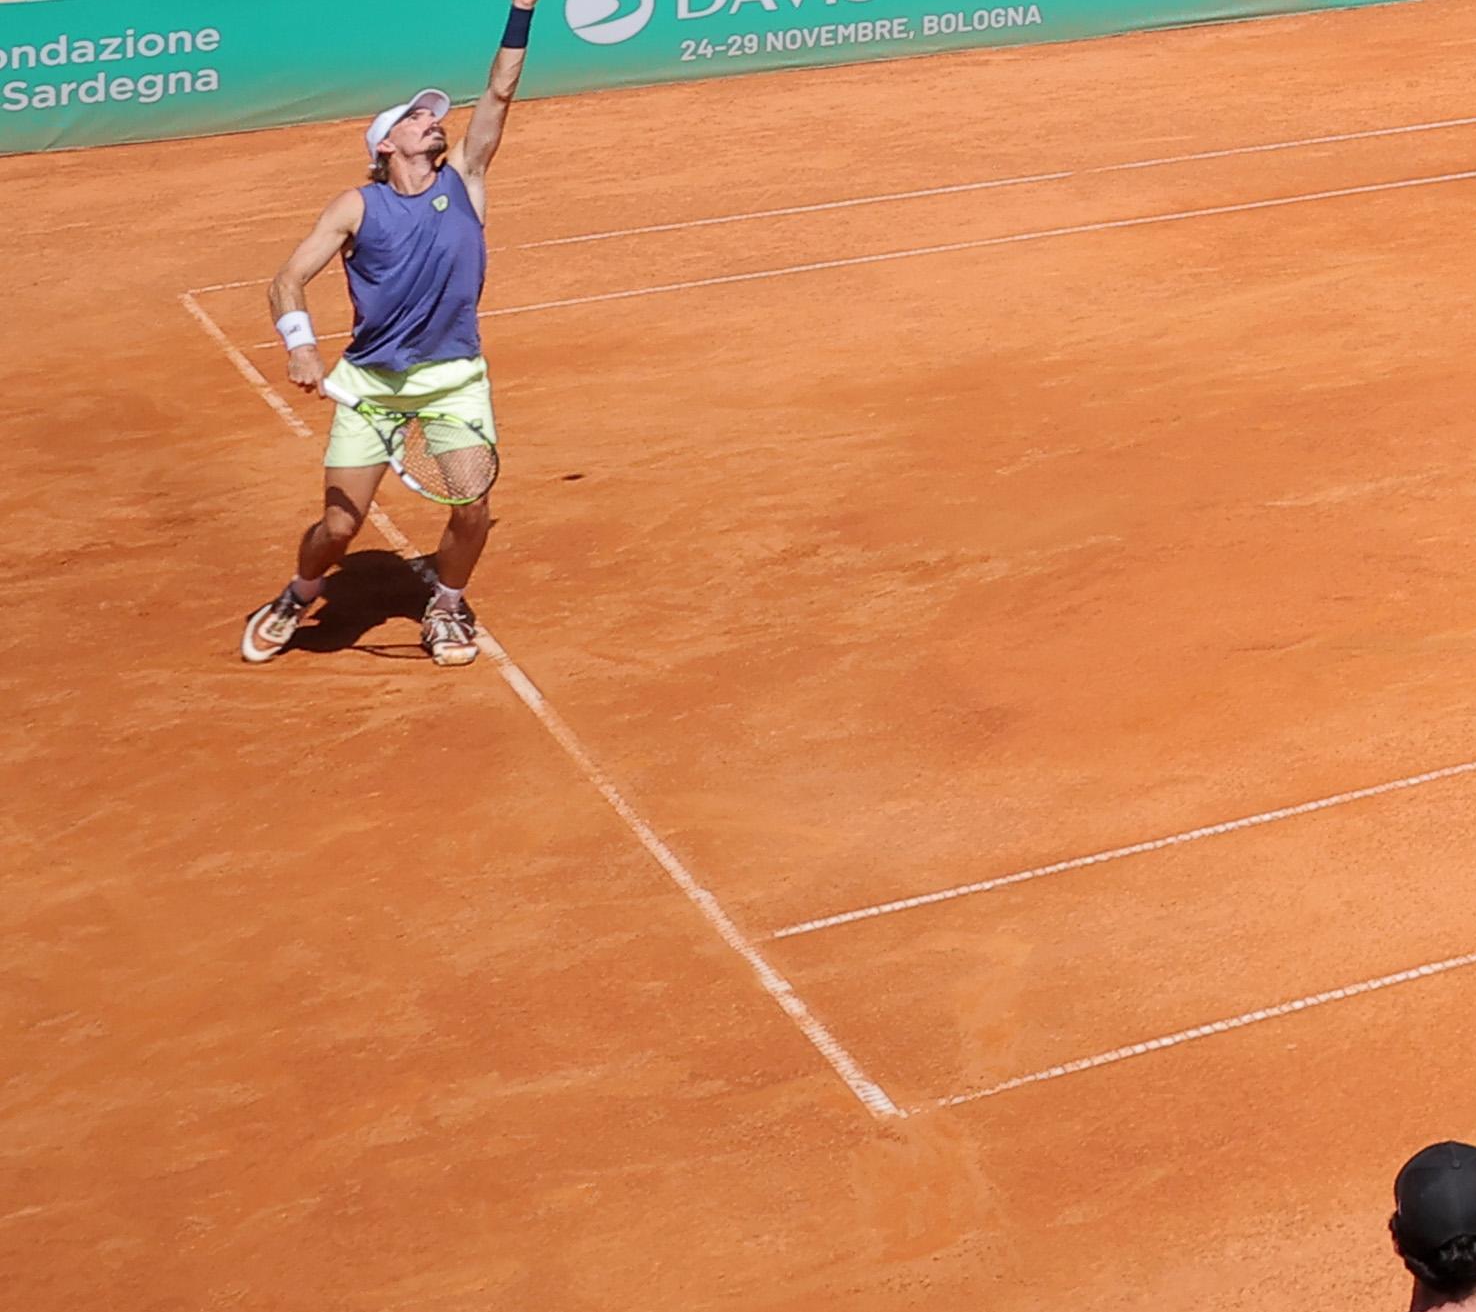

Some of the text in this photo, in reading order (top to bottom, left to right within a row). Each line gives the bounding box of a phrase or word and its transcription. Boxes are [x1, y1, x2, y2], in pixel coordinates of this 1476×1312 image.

[680, 4, 1043, 62] 24-29 NOVEMBRE, BOLOGNA
[2, 67, 220, 112] Sardegna
